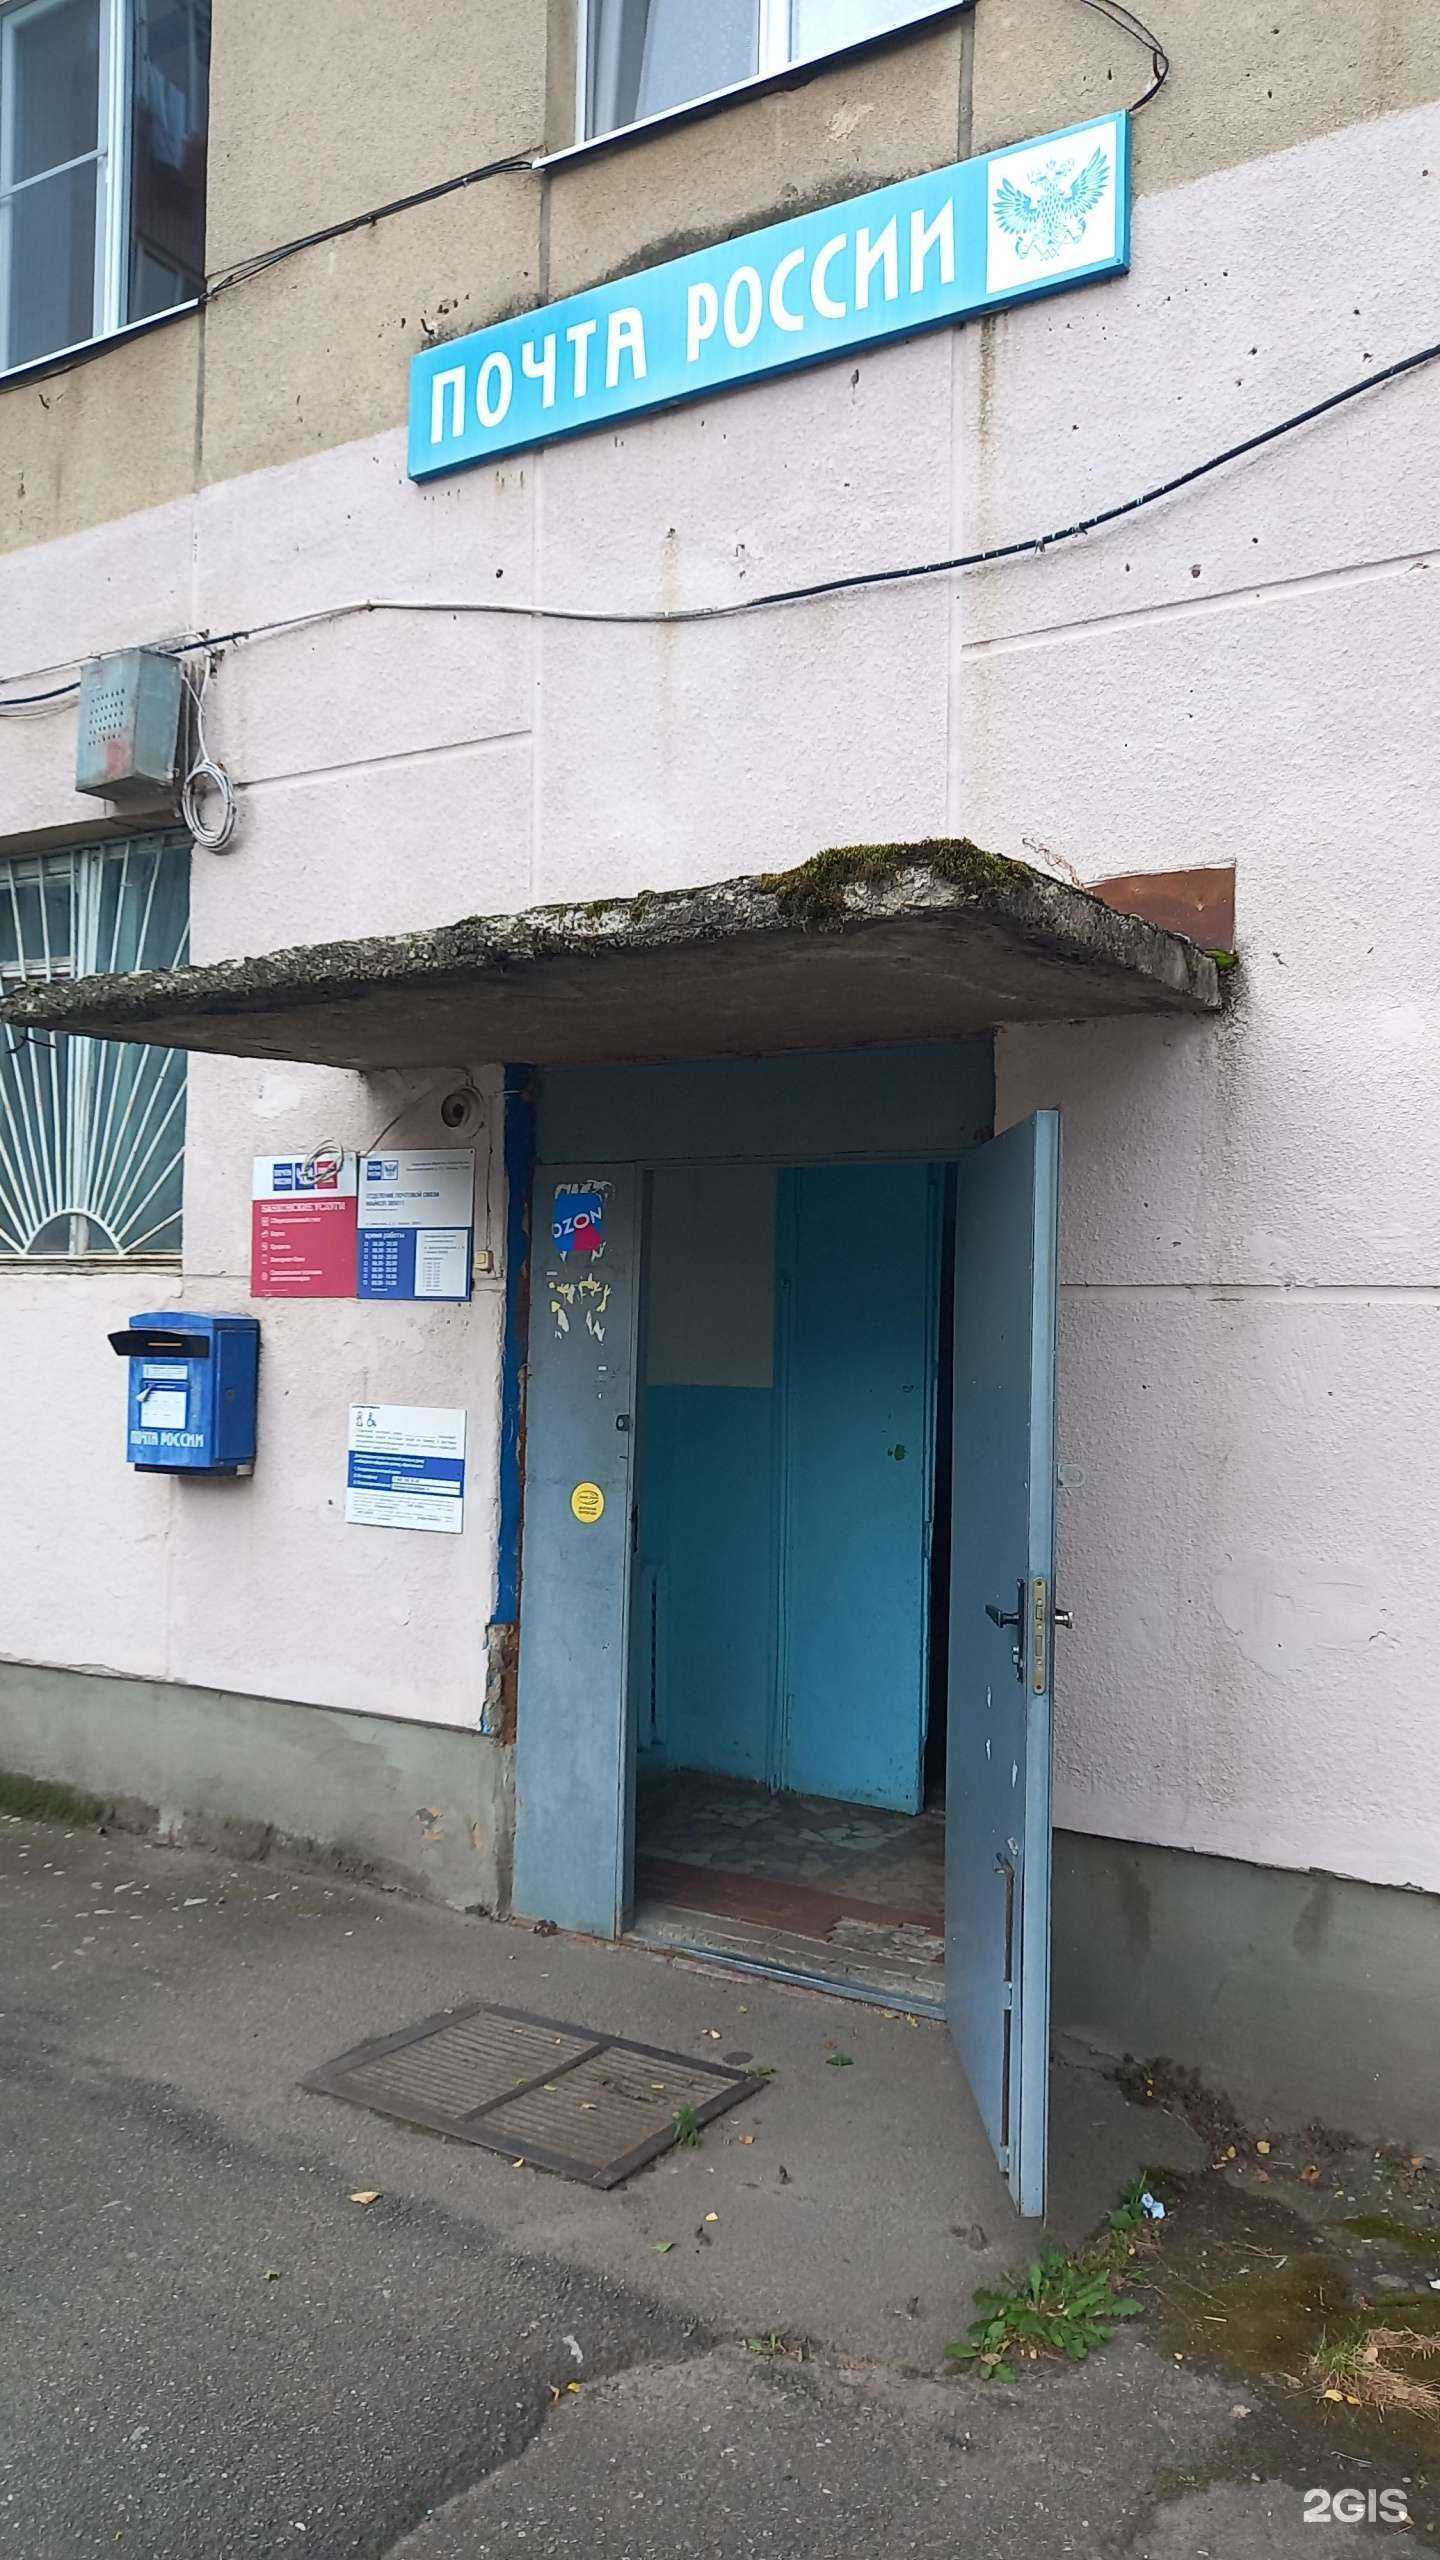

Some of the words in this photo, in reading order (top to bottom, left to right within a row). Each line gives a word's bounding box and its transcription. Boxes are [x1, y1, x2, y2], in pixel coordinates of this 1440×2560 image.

[430, 307, 648, 445] ПОЧТА
[686, 197, 956, 363] РОССИИ
[552, 1207, 602, 1239] OZON
[160, 1432, 204, 1447] РОССИИ
